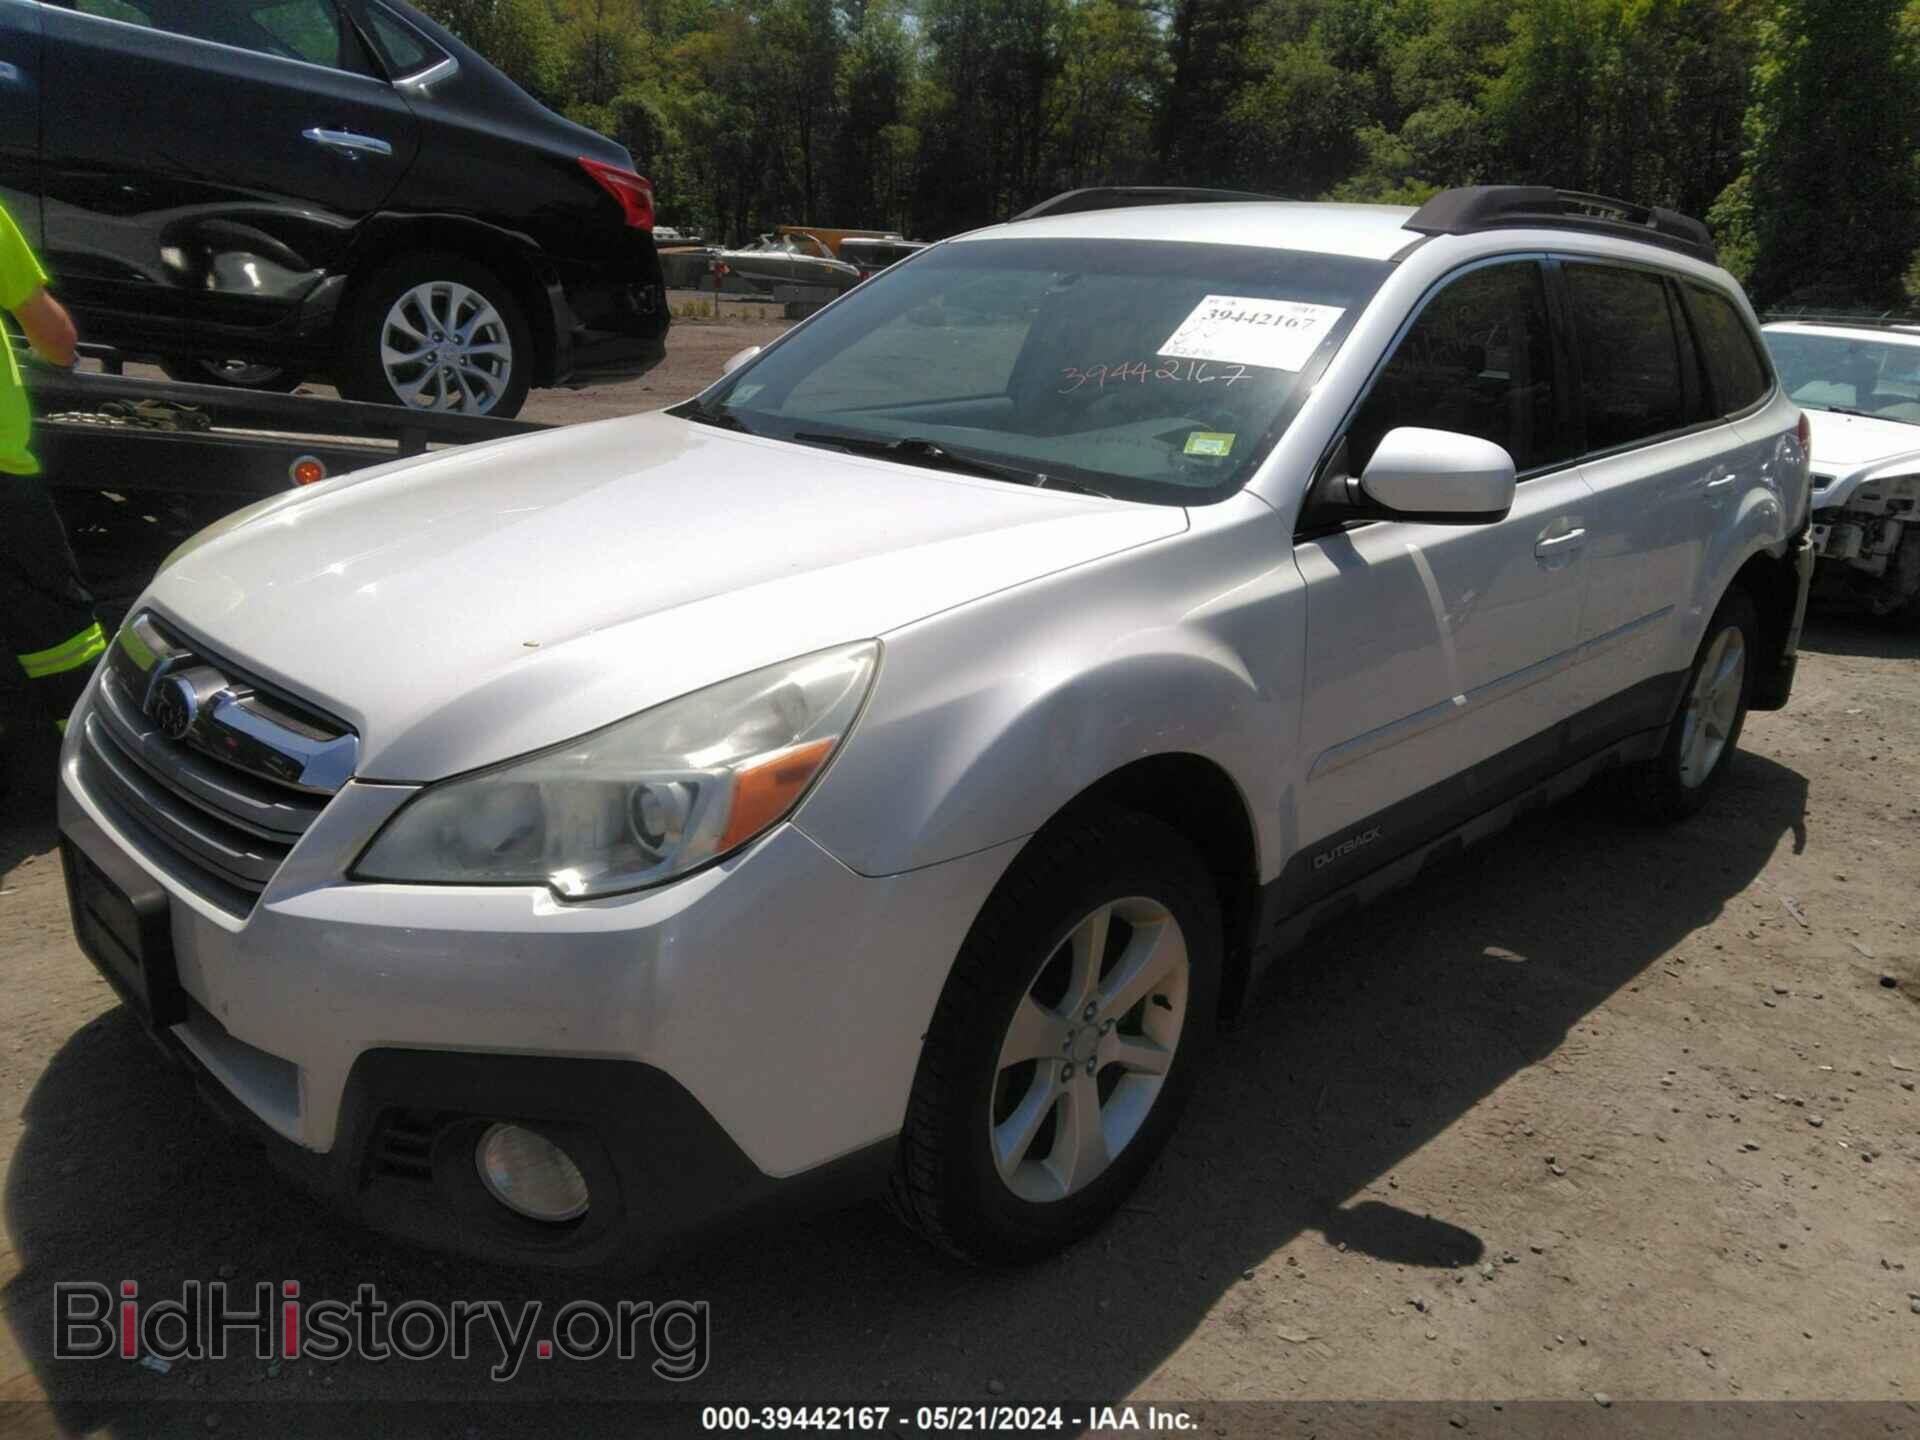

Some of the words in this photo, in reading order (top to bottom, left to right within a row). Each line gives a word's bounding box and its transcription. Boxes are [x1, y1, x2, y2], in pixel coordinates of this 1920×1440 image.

[1200, 308, 1317, 331] 39442167
[1058, 359, 1253, 394] 39442167
[1313, 825, 1383, 869] OUTBACK
